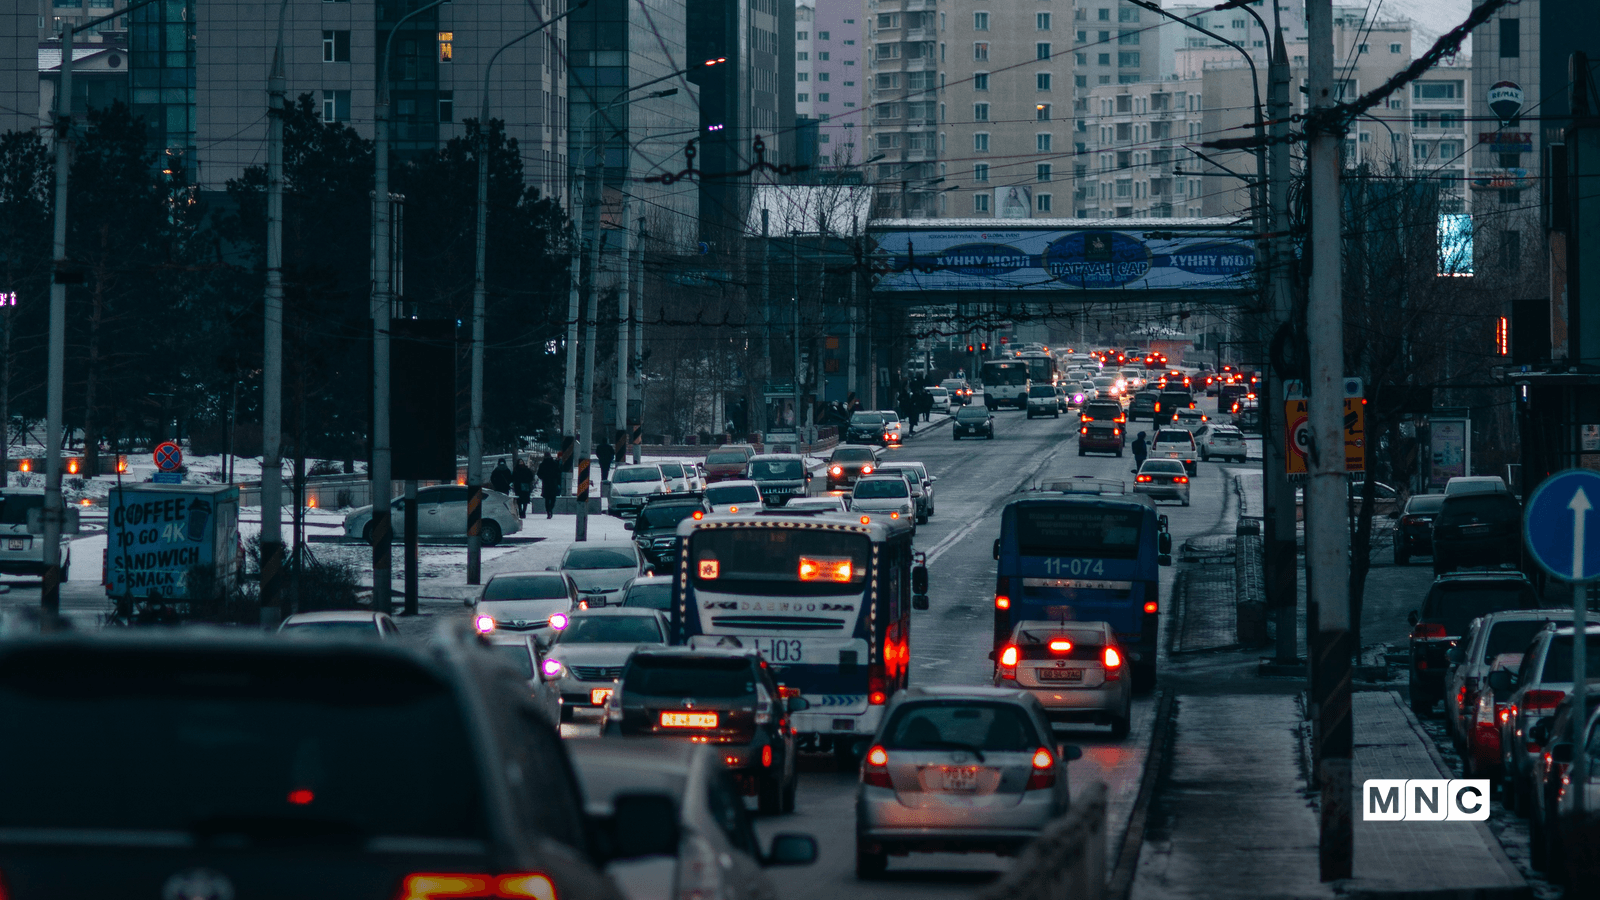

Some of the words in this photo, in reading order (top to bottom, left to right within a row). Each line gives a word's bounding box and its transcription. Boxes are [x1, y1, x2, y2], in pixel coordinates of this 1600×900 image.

[1492, 91, 1520, 99] RE/MAX
[1117, 261, 1148, 275] САР
[114, 498, 185, 527] COFFEE
[117, 531, 134, 548] TO
[139, 529, 158, 545] GO
[162, 522, 185, 544] 4K
[115, 548, 199, 570] SANDWICH
[1044, 558, 1104, 576] 11-074
[127, 572, 174, 588] SNACK
[741, 602, 816, 612] DAEWOO
